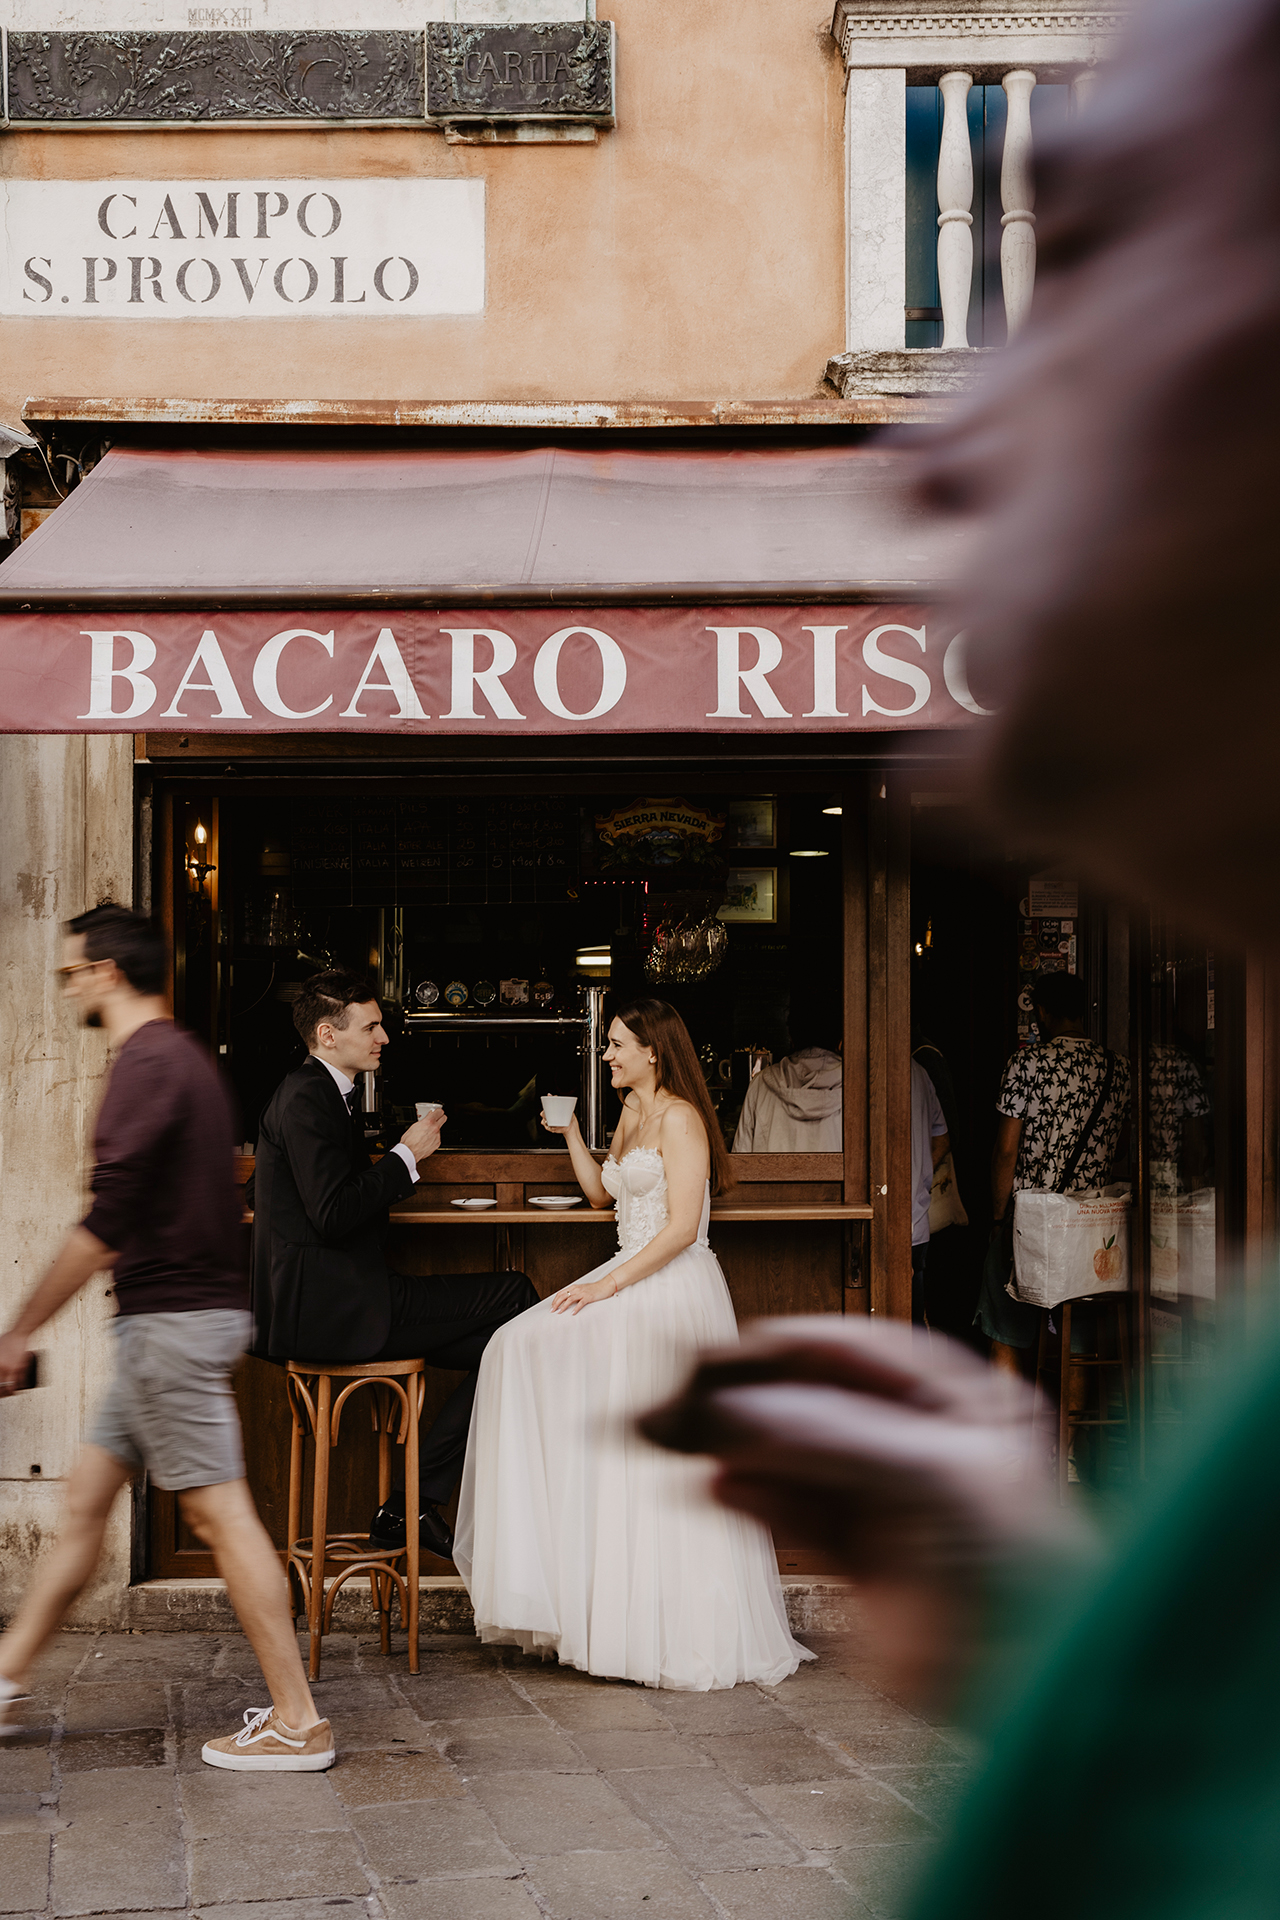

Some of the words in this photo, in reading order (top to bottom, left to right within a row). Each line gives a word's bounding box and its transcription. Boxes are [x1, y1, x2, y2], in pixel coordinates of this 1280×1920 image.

[97, 191, 342, 240] CAMPO
[76, 625, 627, 720] BACARO
[399, 802, 429, 815] PILS
[456, 803, 471, 814] 30
[323, 822, 350, 835] KISS
[358, 822, 390, 834] ITALIA
[402, 820, 432, 834] APA
[612, 811, 659, 832] SIERRA
[659, 811, 707, 831] NEVADA
[359, 841, 388, 851] ITALIA
[426, 840, 445, 850] ALE
[456, 837, 476, 850] 25
[356, 858, 390, 869] ITALIA
[456, 854, 475, 868] 20
[491, 854, 504, 869] 5
